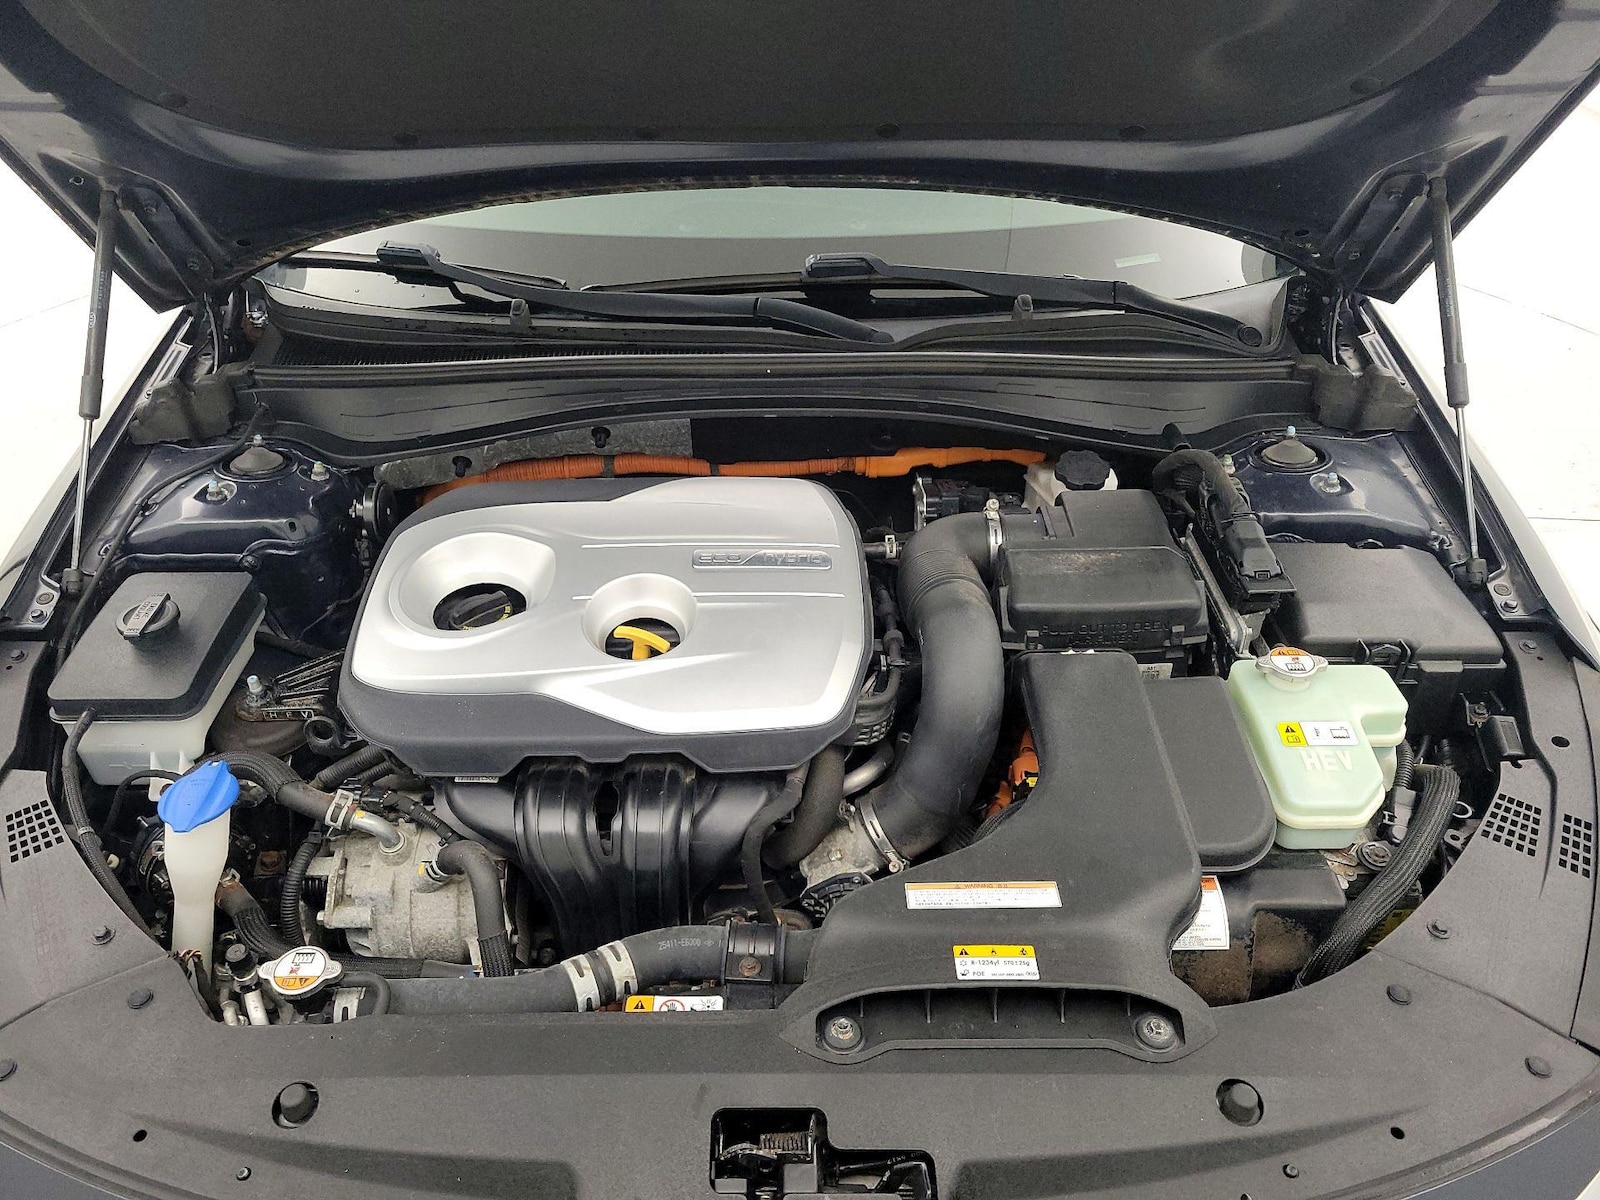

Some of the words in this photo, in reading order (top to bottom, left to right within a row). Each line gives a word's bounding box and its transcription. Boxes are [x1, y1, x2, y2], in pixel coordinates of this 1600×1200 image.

[699, 553, 741, 563] ECO
[1040, 625, 1075, 635] PULL
[1079, 624, 1107, 634] OUT
[1132, 621, 1170, 632] OPEN
[1300, 749, 1353, 772] HEV
